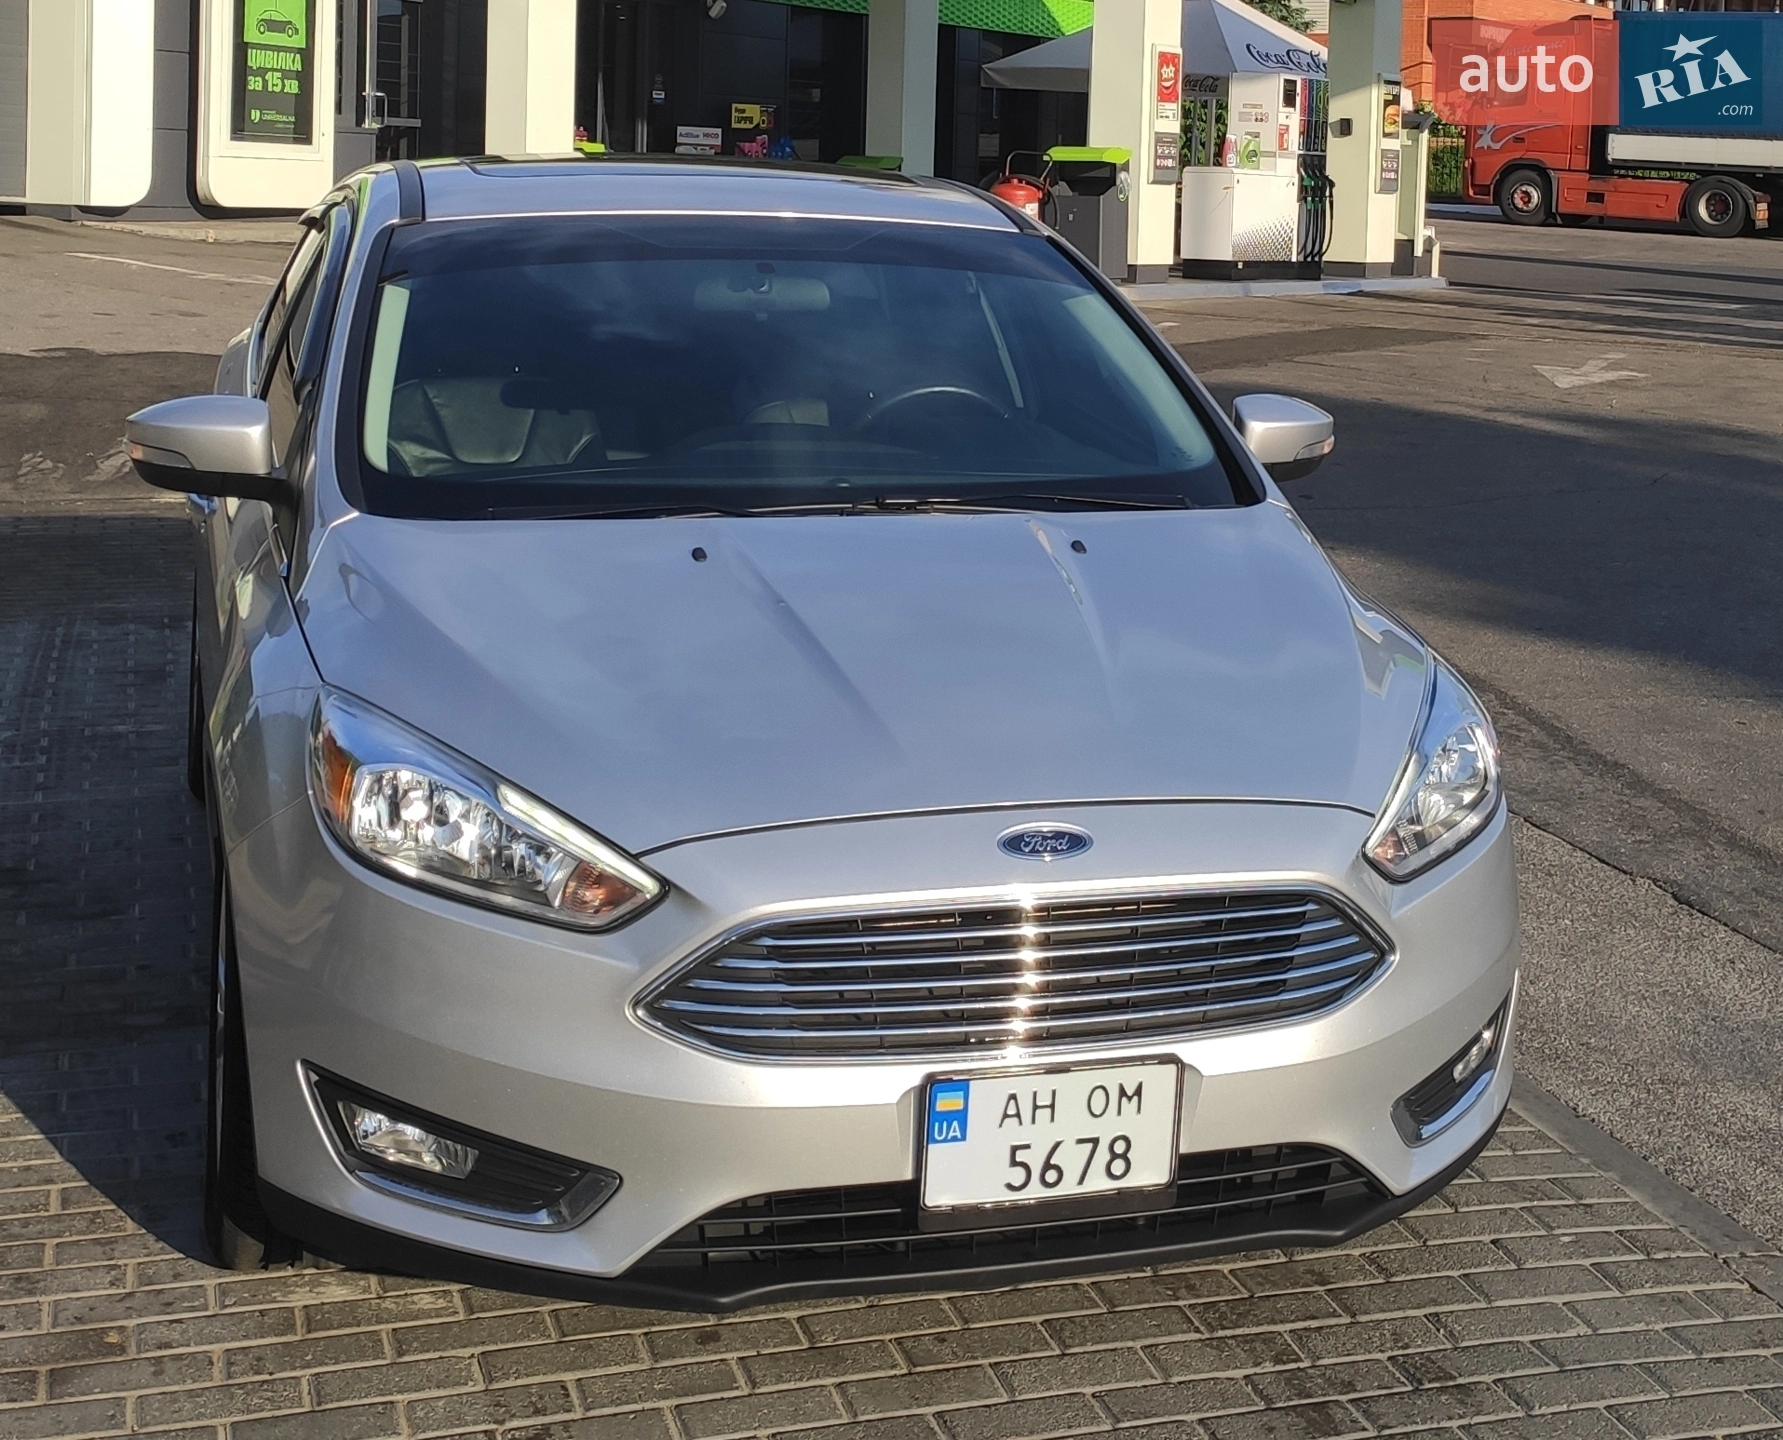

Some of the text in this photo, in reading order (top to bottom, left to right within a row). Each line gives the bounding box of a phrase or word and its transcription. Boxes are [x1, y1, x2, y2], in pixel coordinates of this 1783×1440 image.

[247, 49, 301, 71] ЦИВІЛКА
[248, 76, 262, 90] за
[265, 71, 282, 92] 15
[1020, 832, 1070, 852] Ford
[998, 1078, 1144, 1129] AH OM
[934, 1120, 962, 1141] UA
[1003, 1133, 1133, 1193] 5678
